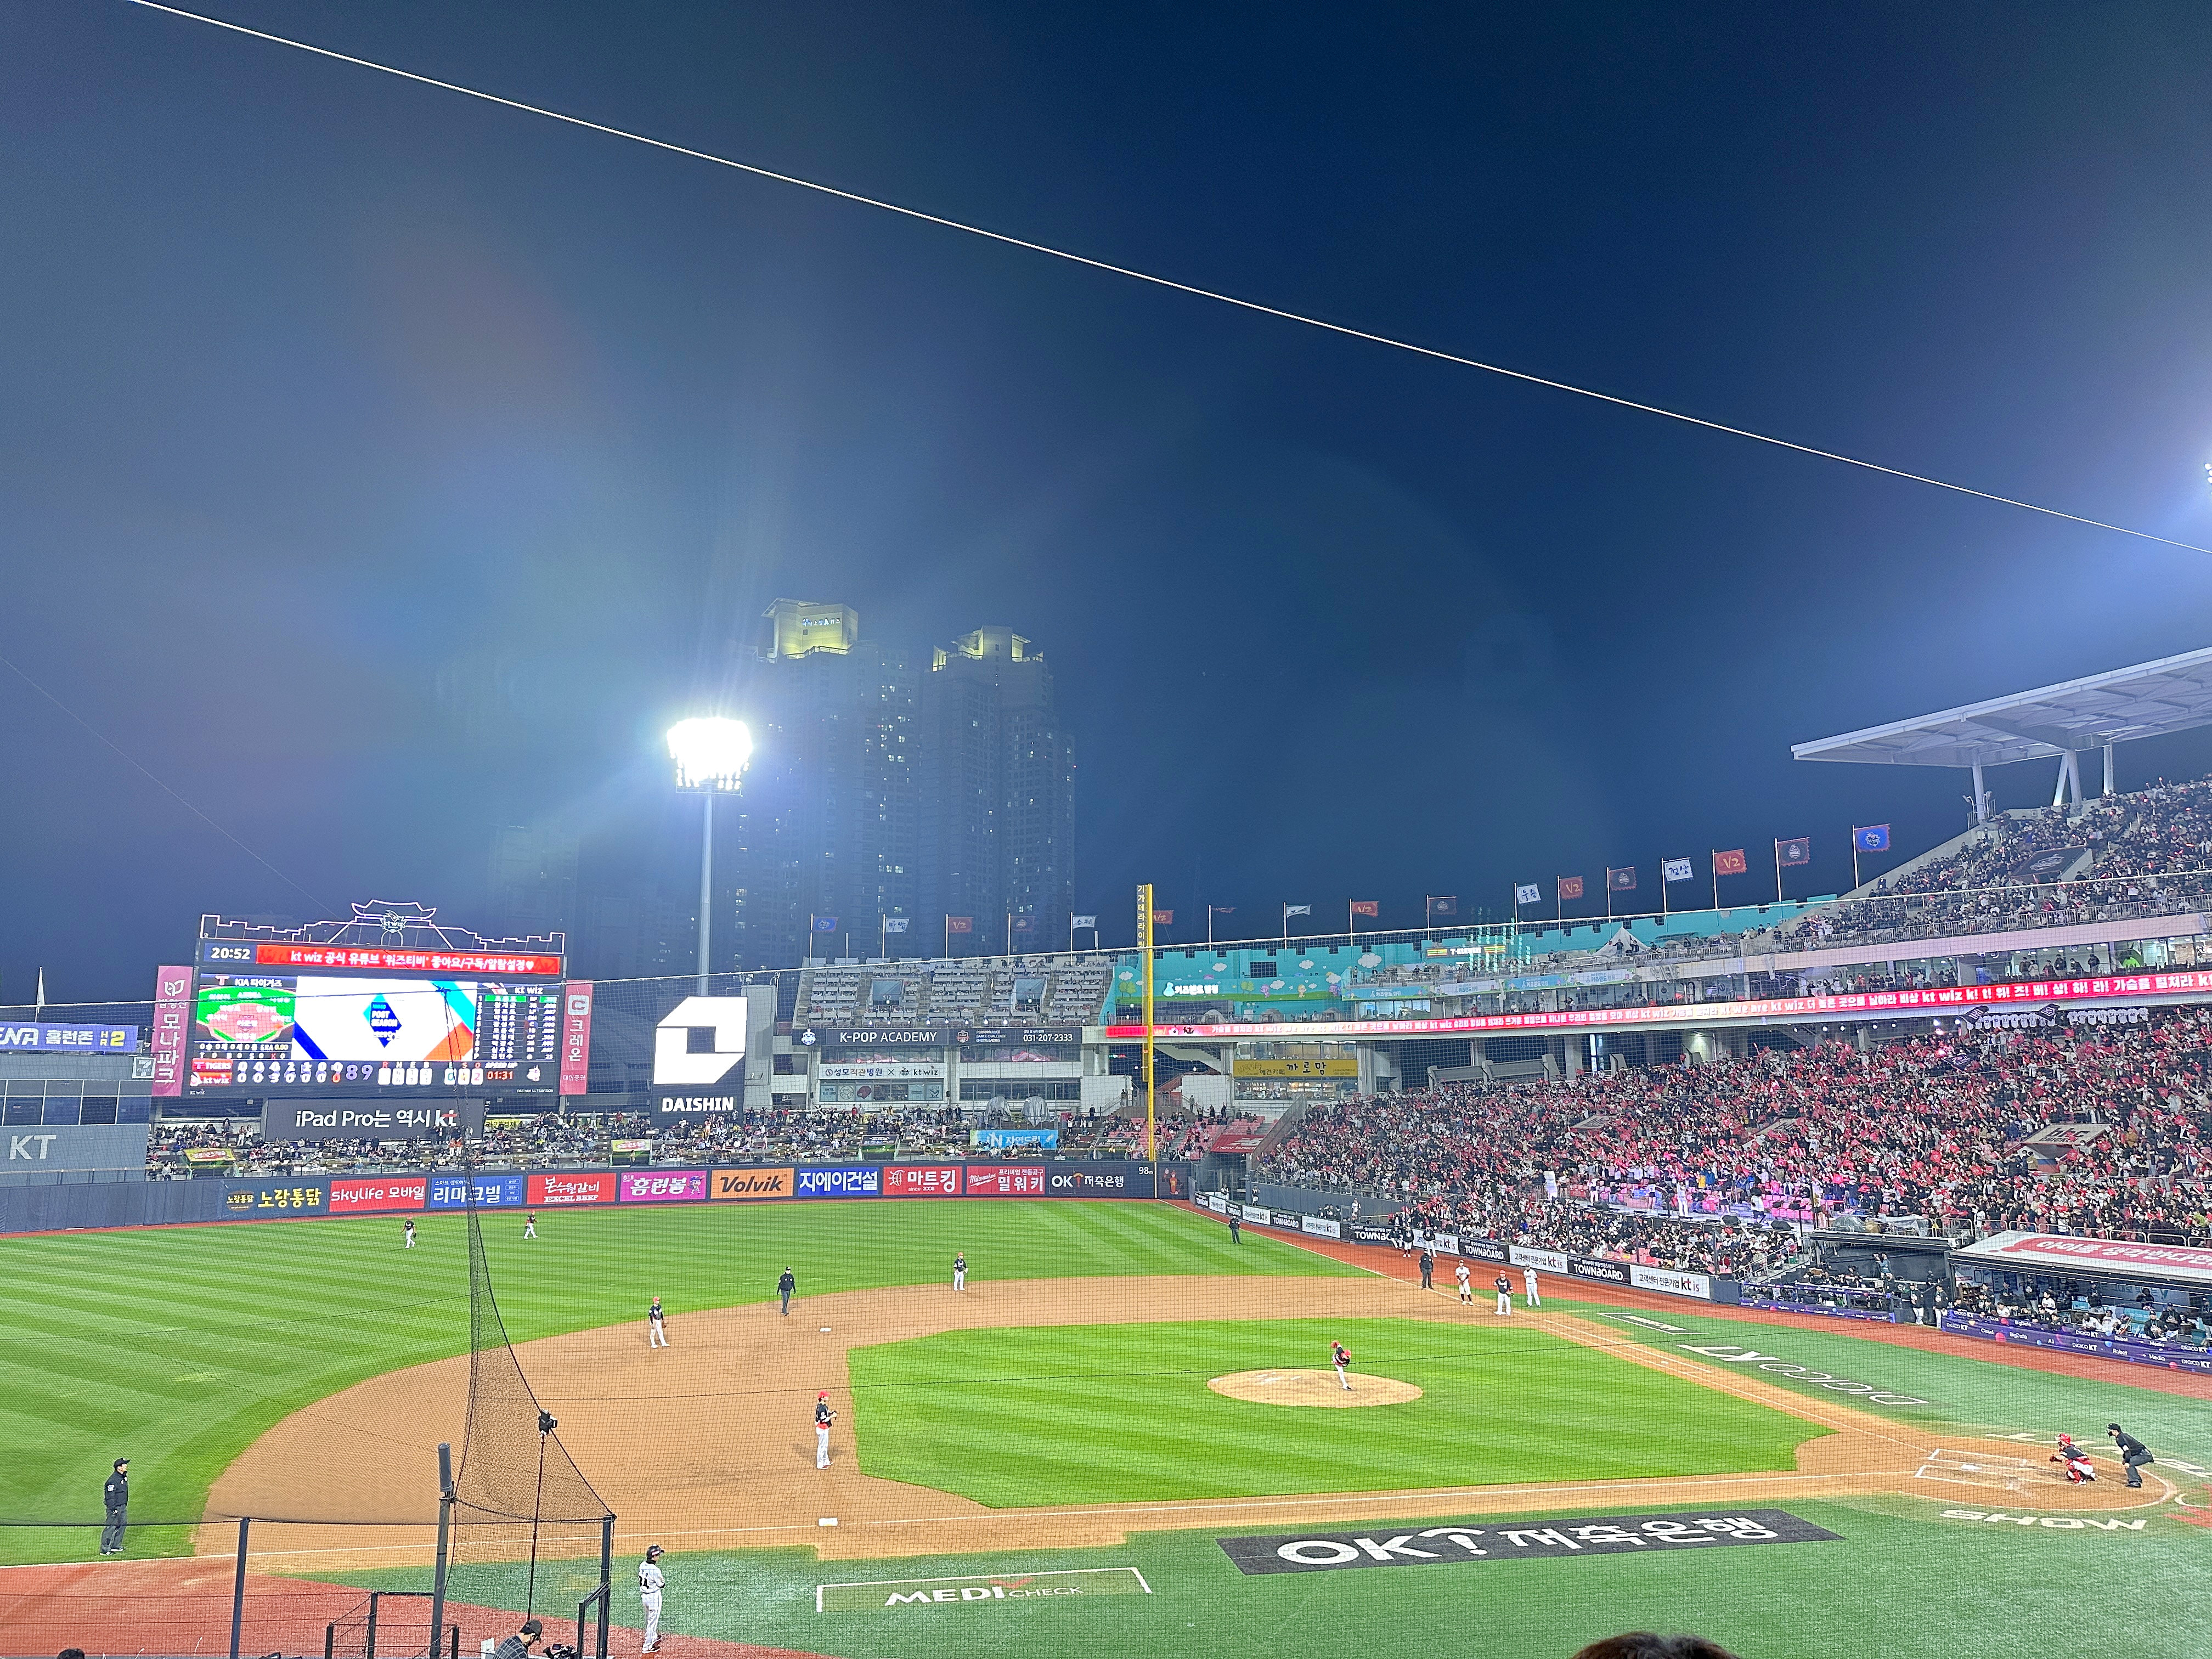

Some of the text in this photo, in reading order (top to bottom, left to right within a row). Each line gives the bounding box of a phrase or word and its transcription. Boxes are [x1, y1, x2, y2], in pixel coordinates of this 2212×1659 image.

[211, 947, 251, 960] 20:52
[291, 951, 301, 961] kt
[304, 952, 323, 962] wiz
[325, 952, 346, 964] 공식
[348, 953, 380, 965] 유튜브
[1771, 1002, 1782, 1012] kt
[1785, 1000, 1805, 1011] wiz
[1922, 991, 1936, 1003] kt
[1939, 990, 1963, 1001] wiz
[1967, 988, 1978, 1000] k!
[2113, 978, 2151, 991] 가슴을
[46, 1030, 93, 1045] 홈런존
[110, 1031, 125, 1046] 2
[840, 1031, 937, 1042] K-POP ACADEMY
[1023, 1034, 1073, 1042] 031-207-2333
[155, 1014, 180, 1083] 모나파크
[487, 1071, 513, 1080] 01:31
[924, 1066, 938, 1075] wiz
[662, 1097, 734, 1112] DAISHIN
[296, 1109, 457, 1128] iPad Pro는 역시 kt
[9, 1135, 57, 1160] KT
[544, 1176, 600, 1194] 본수원갈비
[630, 1177, 687, 1195] 홈런볼
[720, 1176, 784, 1193] Volvik
[799, 1171, 878, 1192] 지에이건설
[907, 1170, 956, 1193] 마트킹
[997, 1177, 1043, 1192] 밀워키
[1051, 1175, 1124, 1188] OK 저축은행
[257, 1187, 322, 1208] 노랑통닭
[331, 1186, 425, 1203] skylife 모바일
[433, 1185, 500, 1204] 리마크빌
[1464, 1245, 1504, 1260] TOWNBOARD
[1548, 1255, 1556, 1267] kt
[1573, 1263, 1623, 1280] TOWNBOARD
[1639, 1274, 1700, 1292] 고객센터 전문기업 kt is
[1939, 1509, 2147, 1531] SHOW
[1276, 1516, 1779, 1566] OK 저축은행
